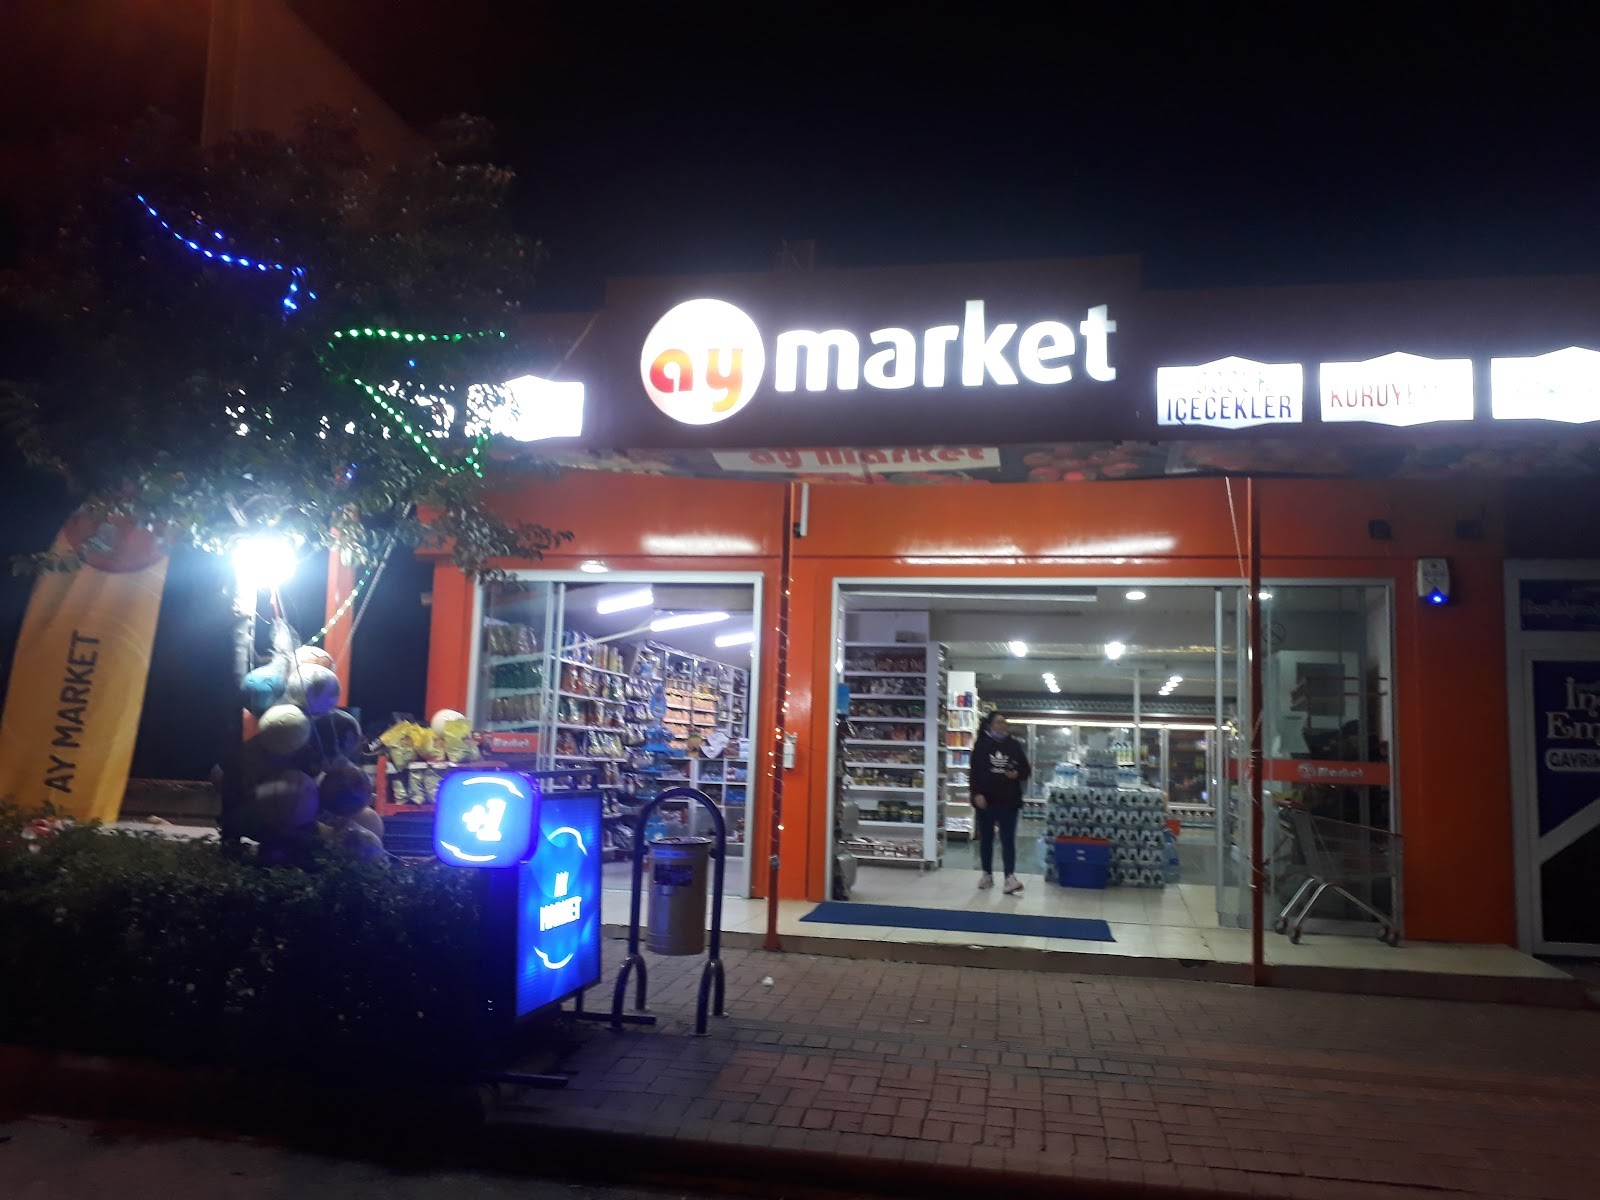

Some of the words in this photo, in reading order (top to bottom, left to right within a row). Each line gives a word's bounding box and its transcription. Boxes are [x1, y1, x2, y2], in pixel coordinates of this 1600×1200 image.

[650, 348, 743, 412] ay
[775, 299, 1117, 392] market
[52, 629, 100, 748] MARKET
[44, 755, 76, 794] AY
